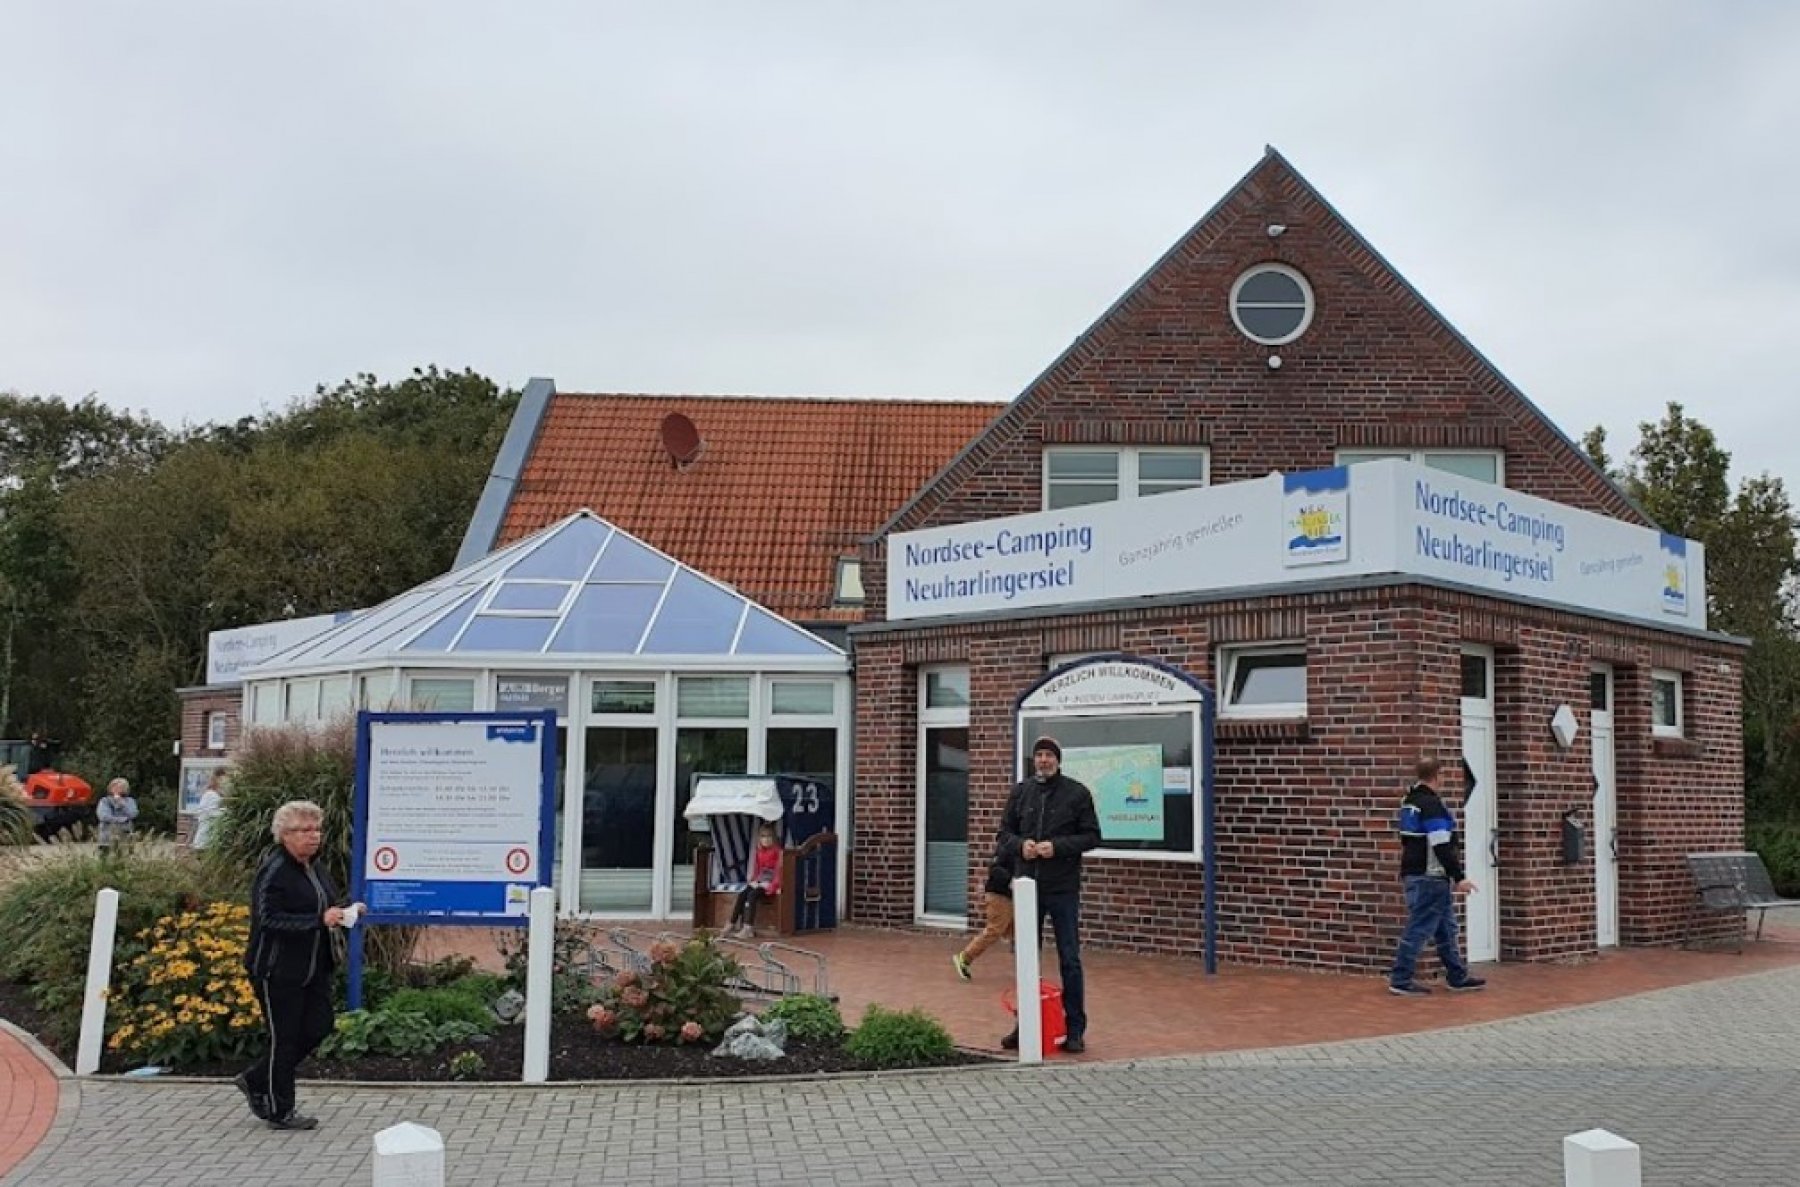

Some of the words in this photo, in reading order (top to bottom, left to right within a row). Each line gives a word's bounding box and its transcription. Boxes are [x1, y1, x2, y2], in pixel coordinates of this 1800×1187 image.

[1415, 480, 1565, 551] Nordsee-Camping
[905, 522, 1092, 567] Nordsee-Camping
[1416, 526, 1554, 582] Neuharlingersiel
[905, 560, 1074, 602] Neuharlingersiel
[1043, 667, 1095, 696] HERZLICH
[1099, 666, 1176, 691] WILLKOMMEN
[791, 783, 820, 814] 23
